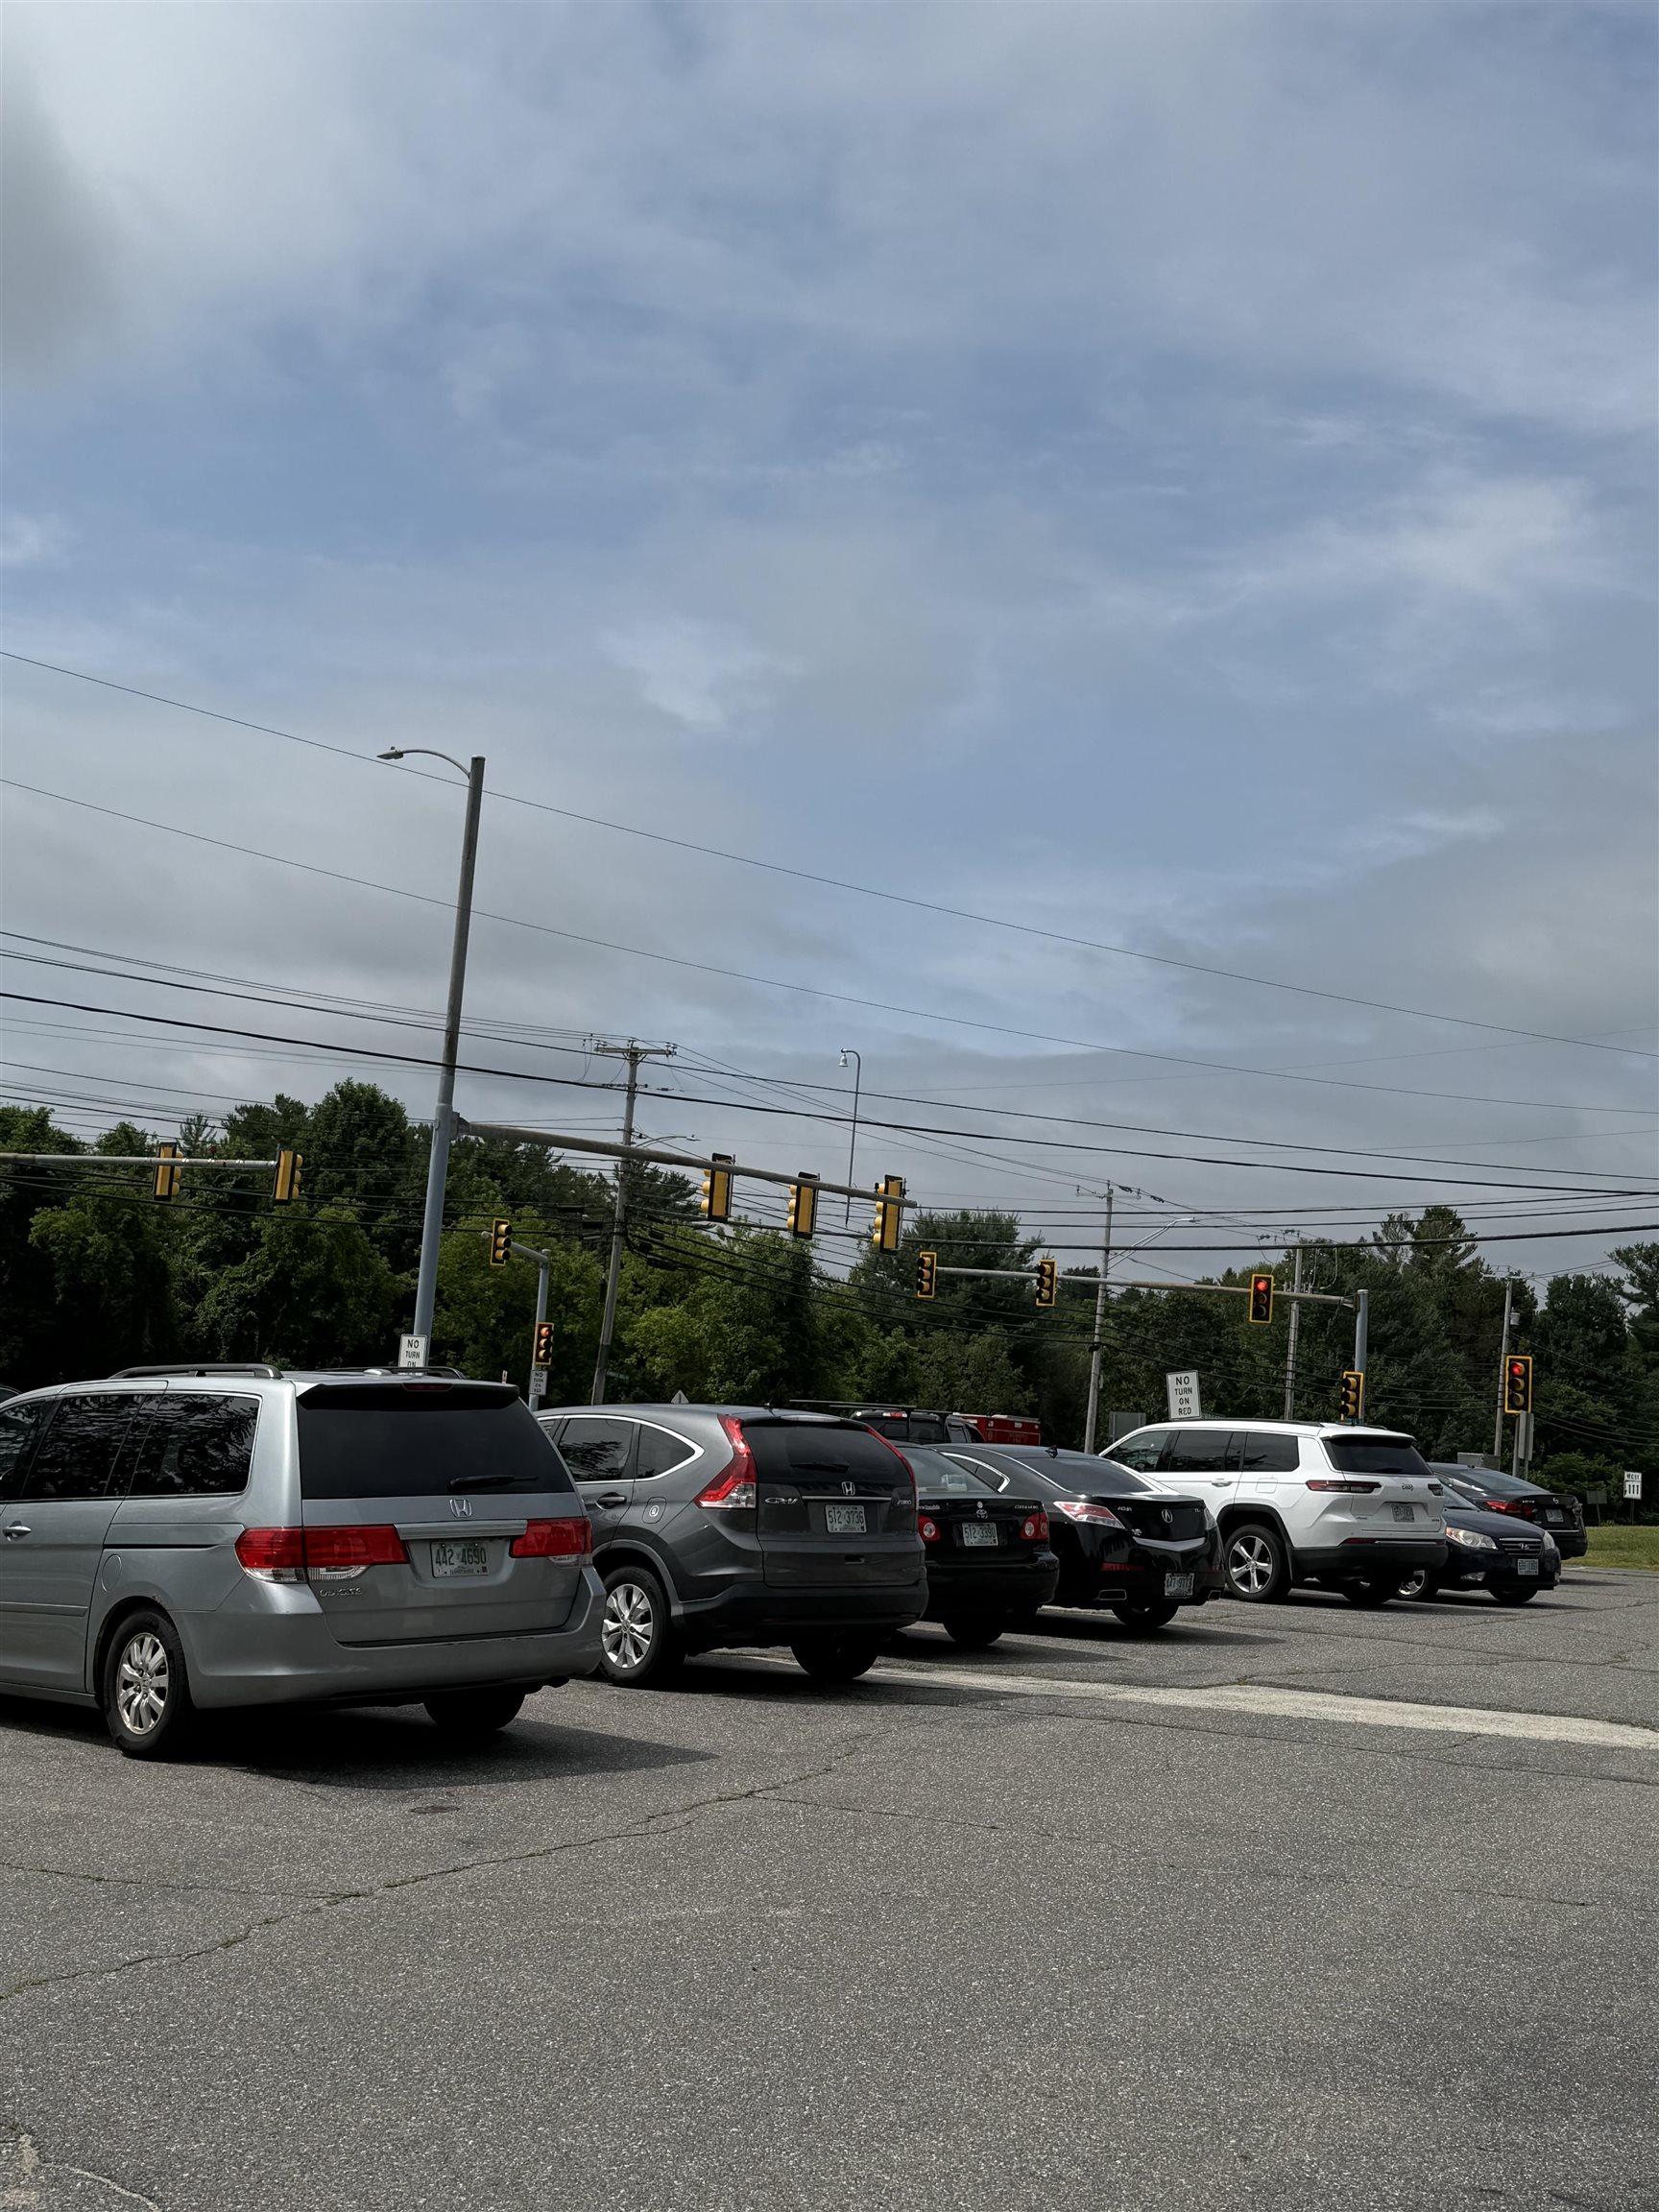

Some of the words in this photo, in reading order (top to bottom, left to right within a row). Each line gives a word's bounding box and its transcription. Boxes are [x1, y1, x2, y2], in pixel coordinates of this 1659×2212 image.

[407, 1338, 420, 1349] NO
[405, 1350, 421, 1359] TURN
[1175, 1375, 1190, 1386] NO
[1174, 1386, 1192, 1396] TURN
[1178, 1397, 1190, 1406] ON
[1178, 1407, 1192, 1416] RED
[1628, 1484, 1640, 1495] 111
[828, 1509, 843, 1524] 512
[845, 1510, 864, 1525] 3736
[964, 1527, 977, 1539] 512
[435, 1548, 455, 1566] 442
[461, 1547, 487, 1565] 4690
